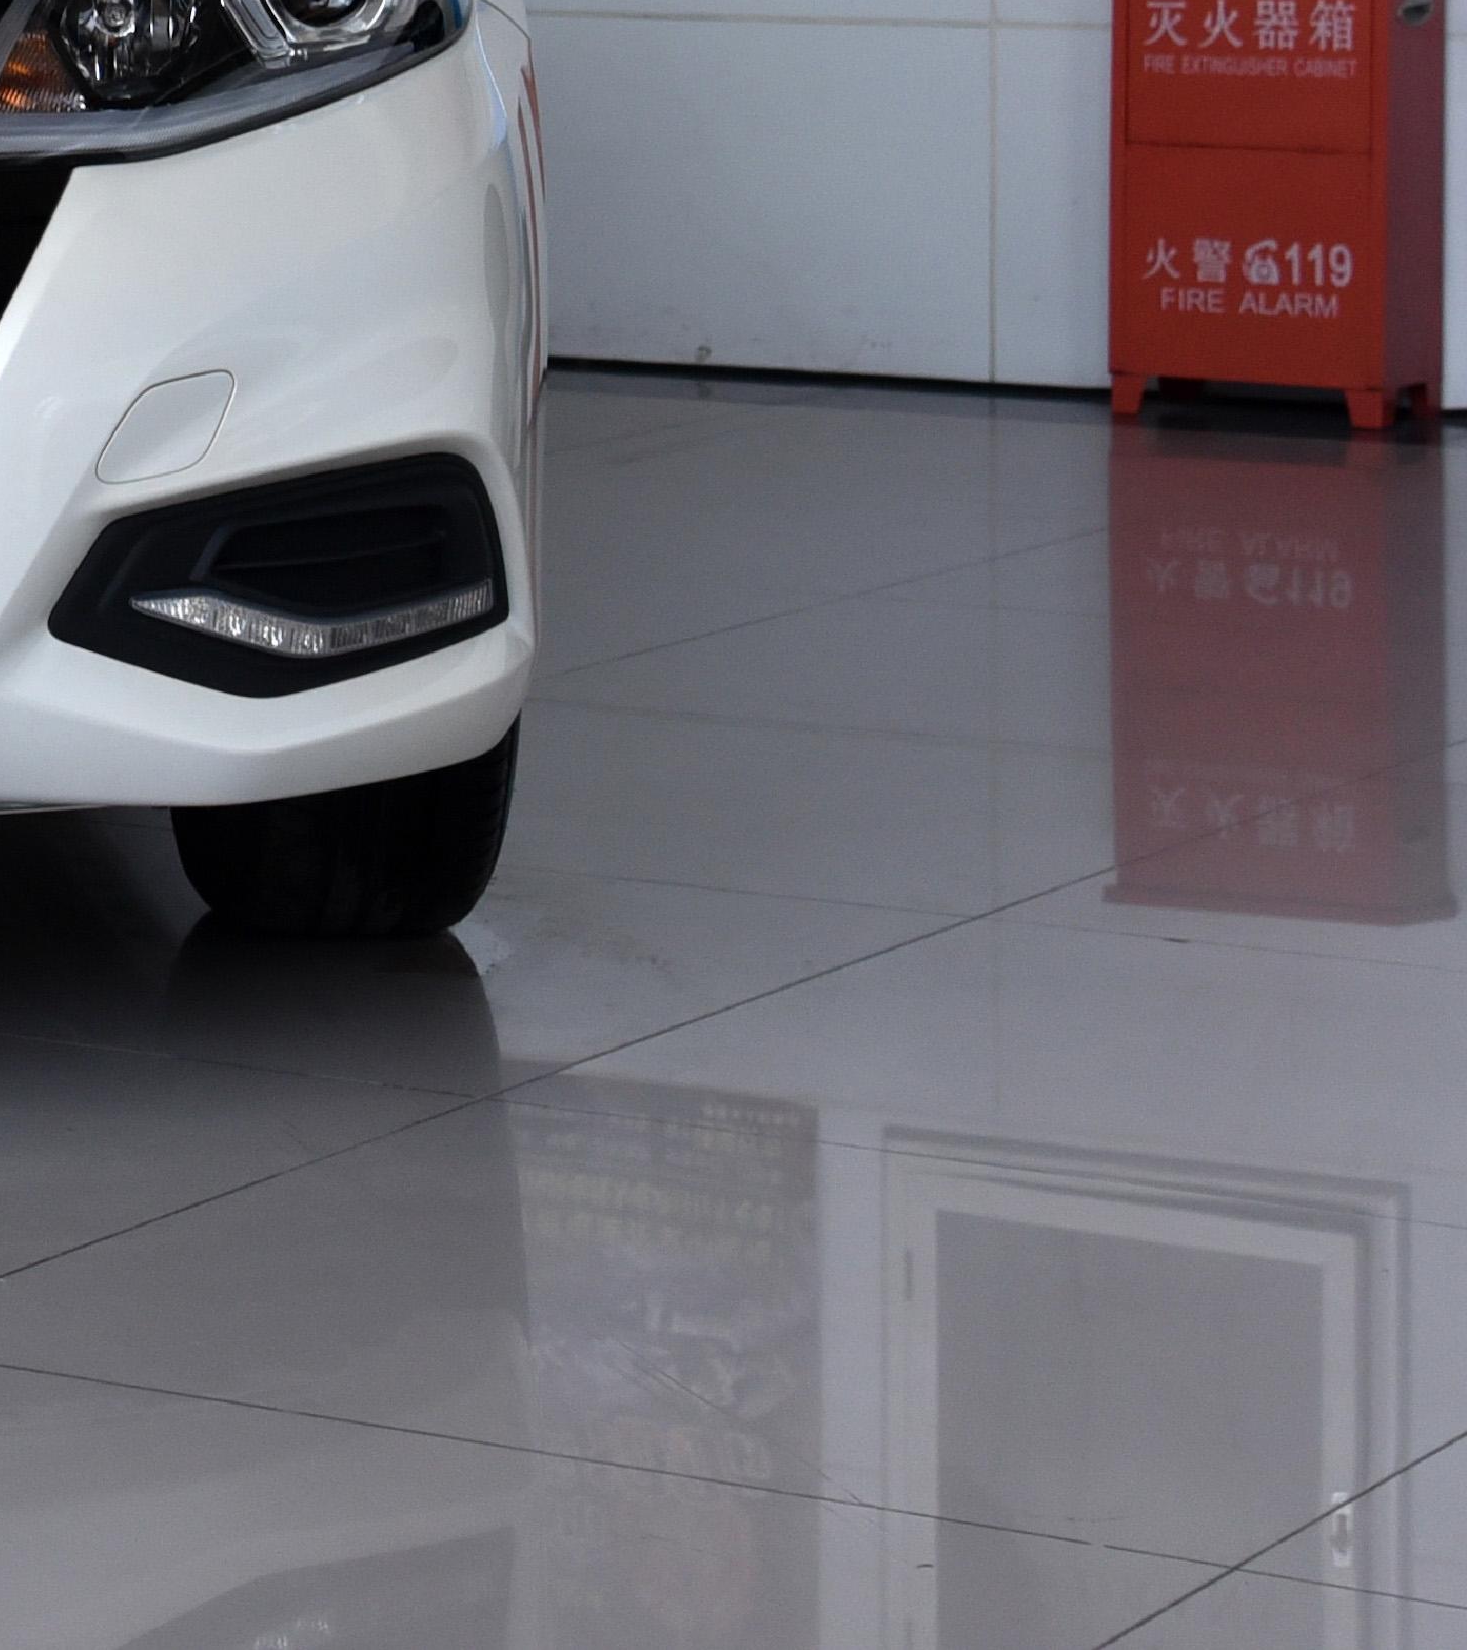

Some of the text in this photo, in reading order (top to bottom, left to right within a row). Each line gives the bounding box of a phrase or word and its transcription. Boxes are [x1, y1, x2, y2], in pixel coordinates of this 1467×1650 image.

[1143, 56, 1175, 75] FIRE
[1293, 59, 1357, 79] CABINET
[1145, 238, 1353, 288] 火警 119
[1160, 287, 1339, 319] FIRE ALARM
